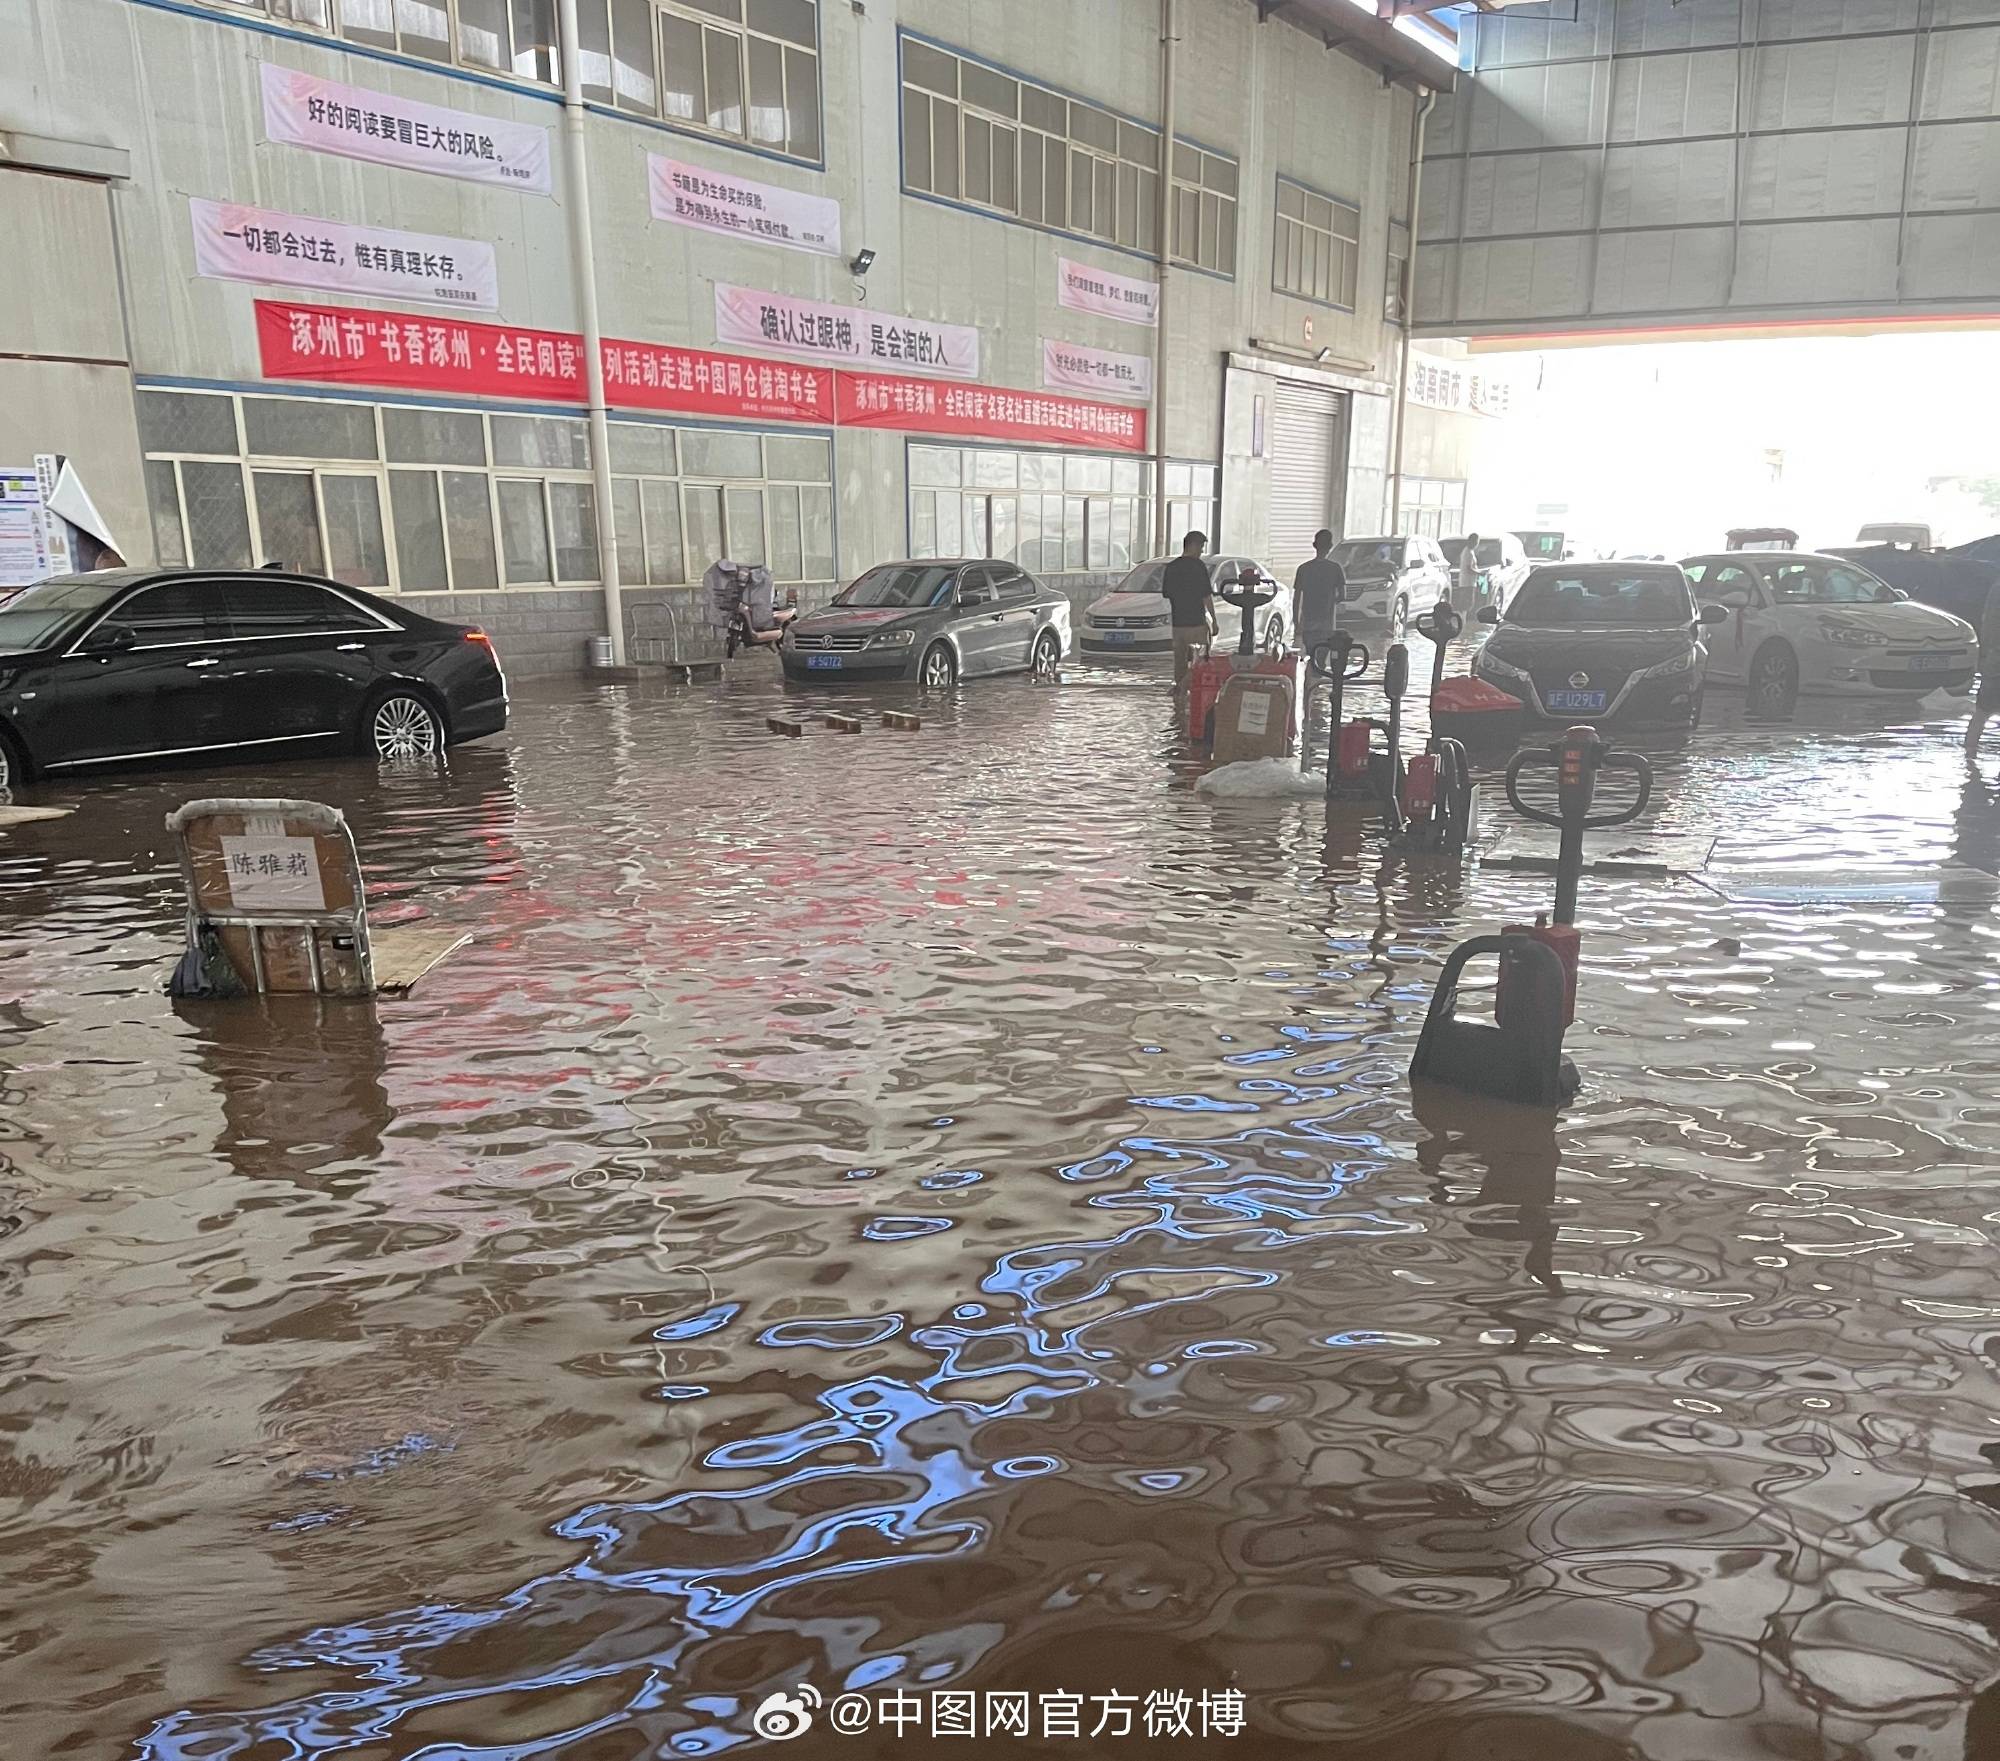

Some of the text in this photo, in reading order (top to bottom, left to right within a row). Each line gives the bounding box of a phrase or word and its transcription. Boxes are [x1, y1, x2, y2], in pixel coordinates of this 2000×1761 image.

[308, 96, 505, 163] 好的阅读要冒巨大的风险。
[223, 224, 464, 281] 一切都会过去，惟有真理长存。
[760, 304, 949, 366] 确认过眼神，是会淘的人
[231, 852, 308, 876] 陈雅莉
